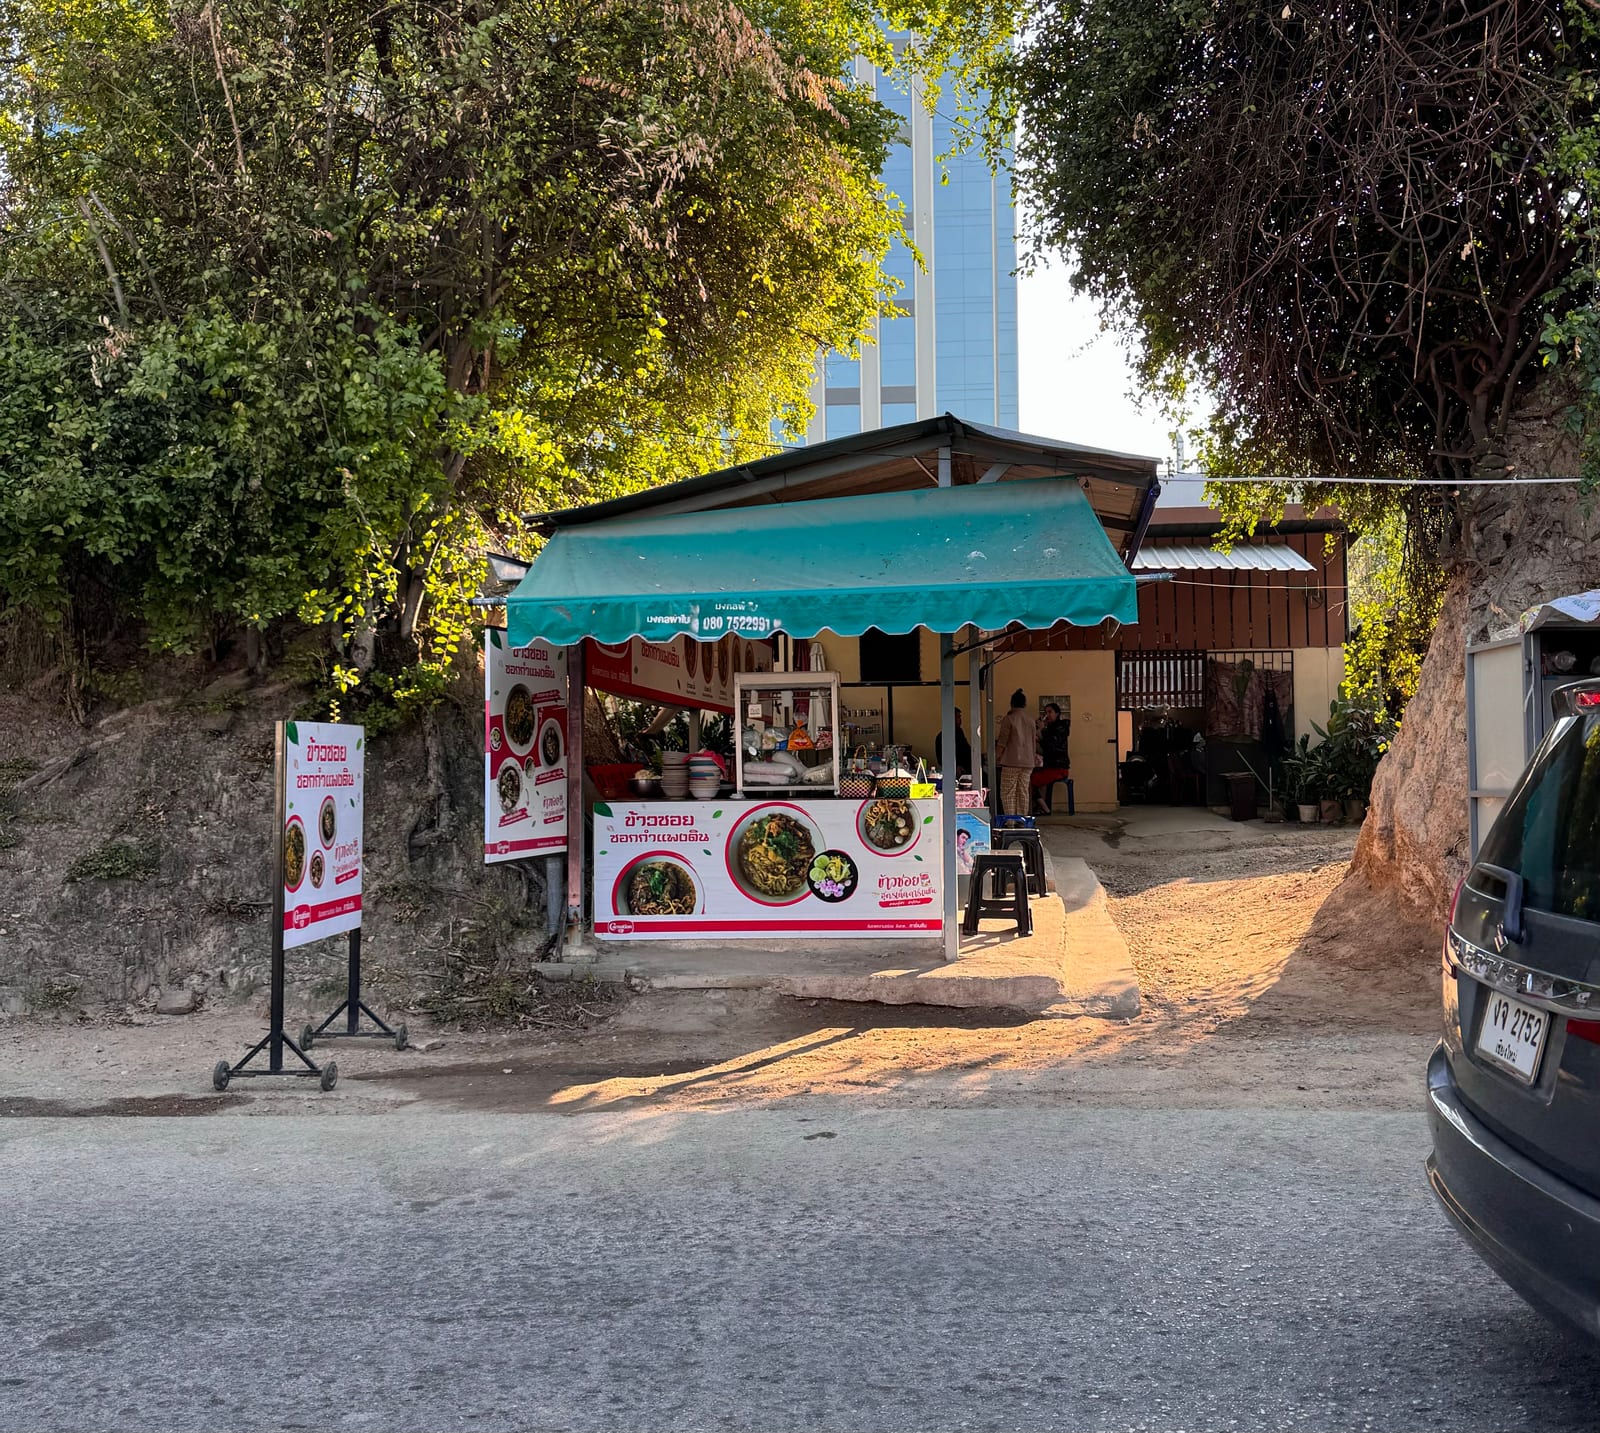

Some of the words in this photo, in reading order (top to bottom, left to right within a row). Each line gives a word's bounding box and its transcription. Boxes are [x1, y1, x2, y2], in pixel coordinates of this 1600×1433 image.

[703, 616, 723, 630] 080
[726, 616, 771, 631] 7522991
[513, 647, 548, 661] ขาวซอย
[1510, 1007, 1541, 1048] 2752
[1495, 1039, 1518, 1063] เชียงใหม่
